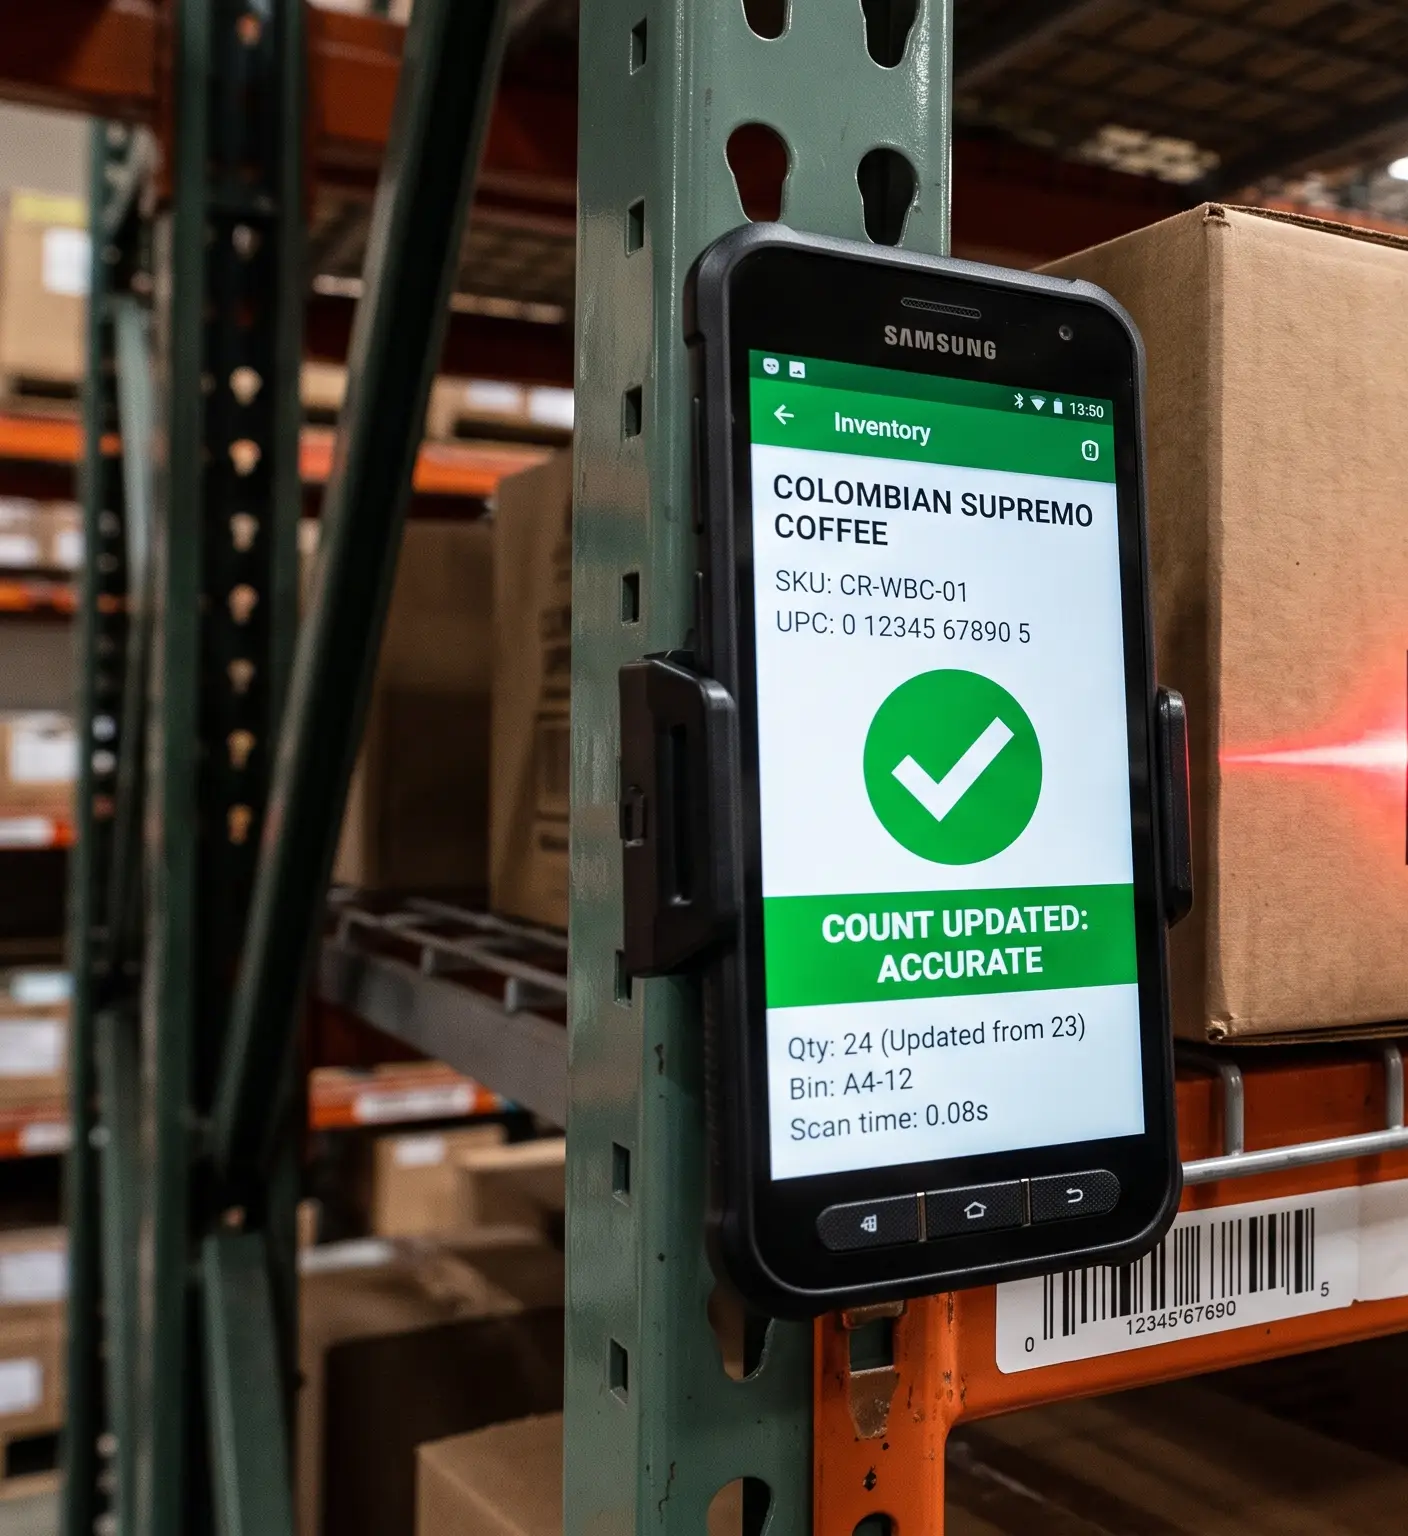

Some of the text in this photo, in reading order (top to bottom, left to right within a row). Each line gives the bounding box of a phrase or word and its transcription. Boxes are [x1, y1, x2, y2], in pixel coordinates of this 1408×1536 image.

[884, 324, 997, 360] SAMSUNG
[1068, 402, 1105, 419] 13:50
[834, 412, 931, 446] Inventory
[773, 474, 1094, 527] COLOMBIAN SUPREMO
[774, 513, 889, 546] COFFEE
[775, 569, 968, 603] SKU: CR-WBC-01
[776, 610, 1031, 644] UPC: 0 12345 67890 5
[822, 904, 1089, 943] COUNT UPDATED:
[877, 946, 1043, 983] ACCURATE
[788, 1013, 1087, 1064] Qty: 24 (Updated from 23)
[790, 1068, 914, 1101] Bin: A4-12
[790, 1100, 989, 1142] Scan time: 0.08s
[1024, 1336, 1035, 1352] 0
[1320, 1281, 1330, 1297] 5
